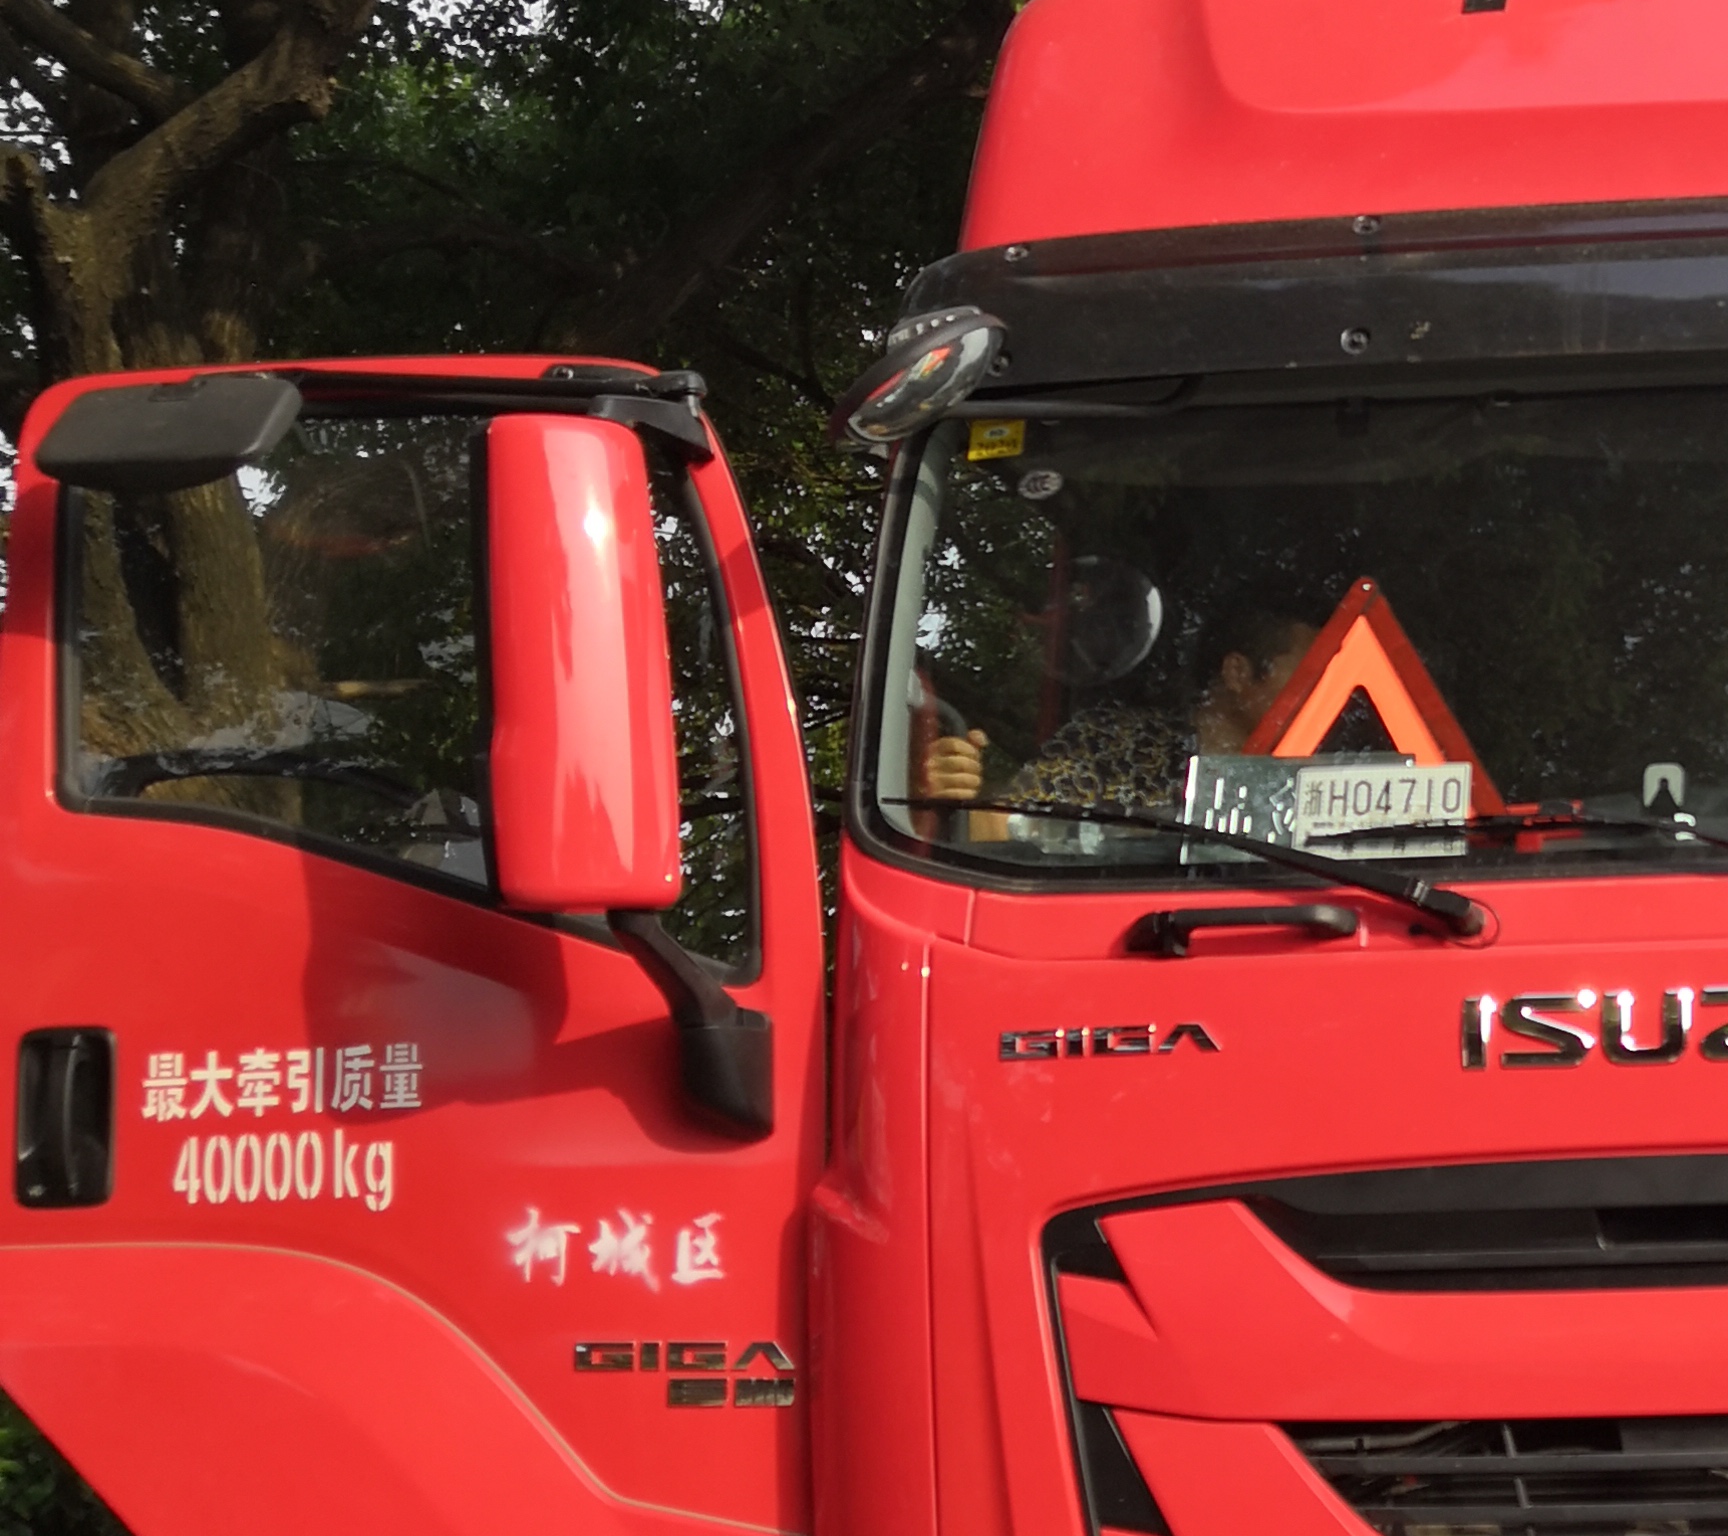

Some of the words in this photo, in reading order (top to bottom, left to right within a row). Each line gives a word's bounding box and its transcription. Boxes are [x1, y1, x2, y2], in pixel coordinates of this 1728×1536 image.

[999, 1023, 1222, 1062] GIGA
[142, 1042, 424, 1122] 最大牵引质量
[506, 1207, 727, 1293] 柯城区
[573, 1339, 797, 1372] GIGA
